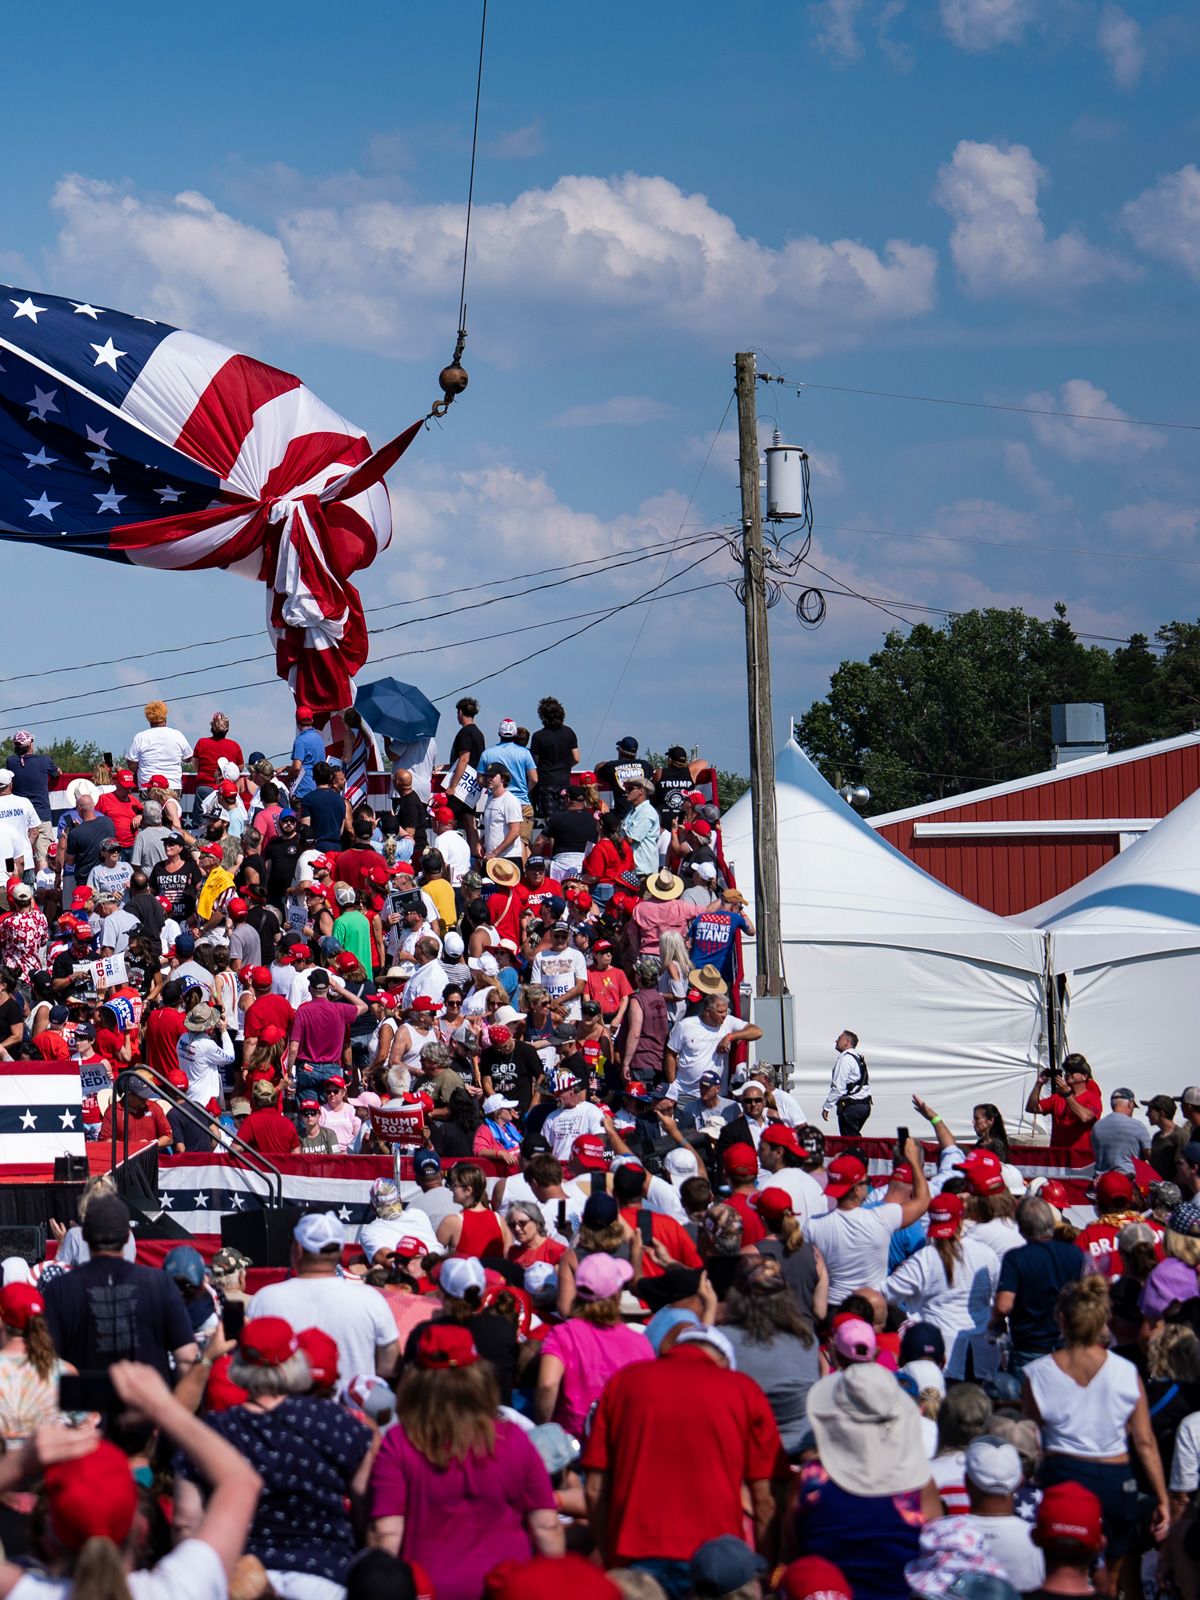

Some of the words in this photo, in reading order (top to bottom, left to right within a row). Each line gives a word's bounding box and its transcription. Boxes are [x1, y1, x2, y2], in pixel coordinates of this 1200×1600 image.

[617, 770, 642, 779] TRUMP
[660, 780, 693, 789] TRUMP
[14, 808, 24, 817] DON
[105, 872, 130, 882] TRUMP
[110, 883, 126, 893] 202
[697, 922, 719, 931] UNITED
[720, 923, 731, 933] WE
[696, 929, 730, 943] STAND
[545, 985, 569, 994] U'RE
[491, 1063, 516, 1073] GOD
[81, 1070, 102, 1079] U'RE
[81, 1076, 108, 1087] RED!
[374, 1115, 419, 1127] TRUMP
[381, 1125, 414, 1134] 2024
